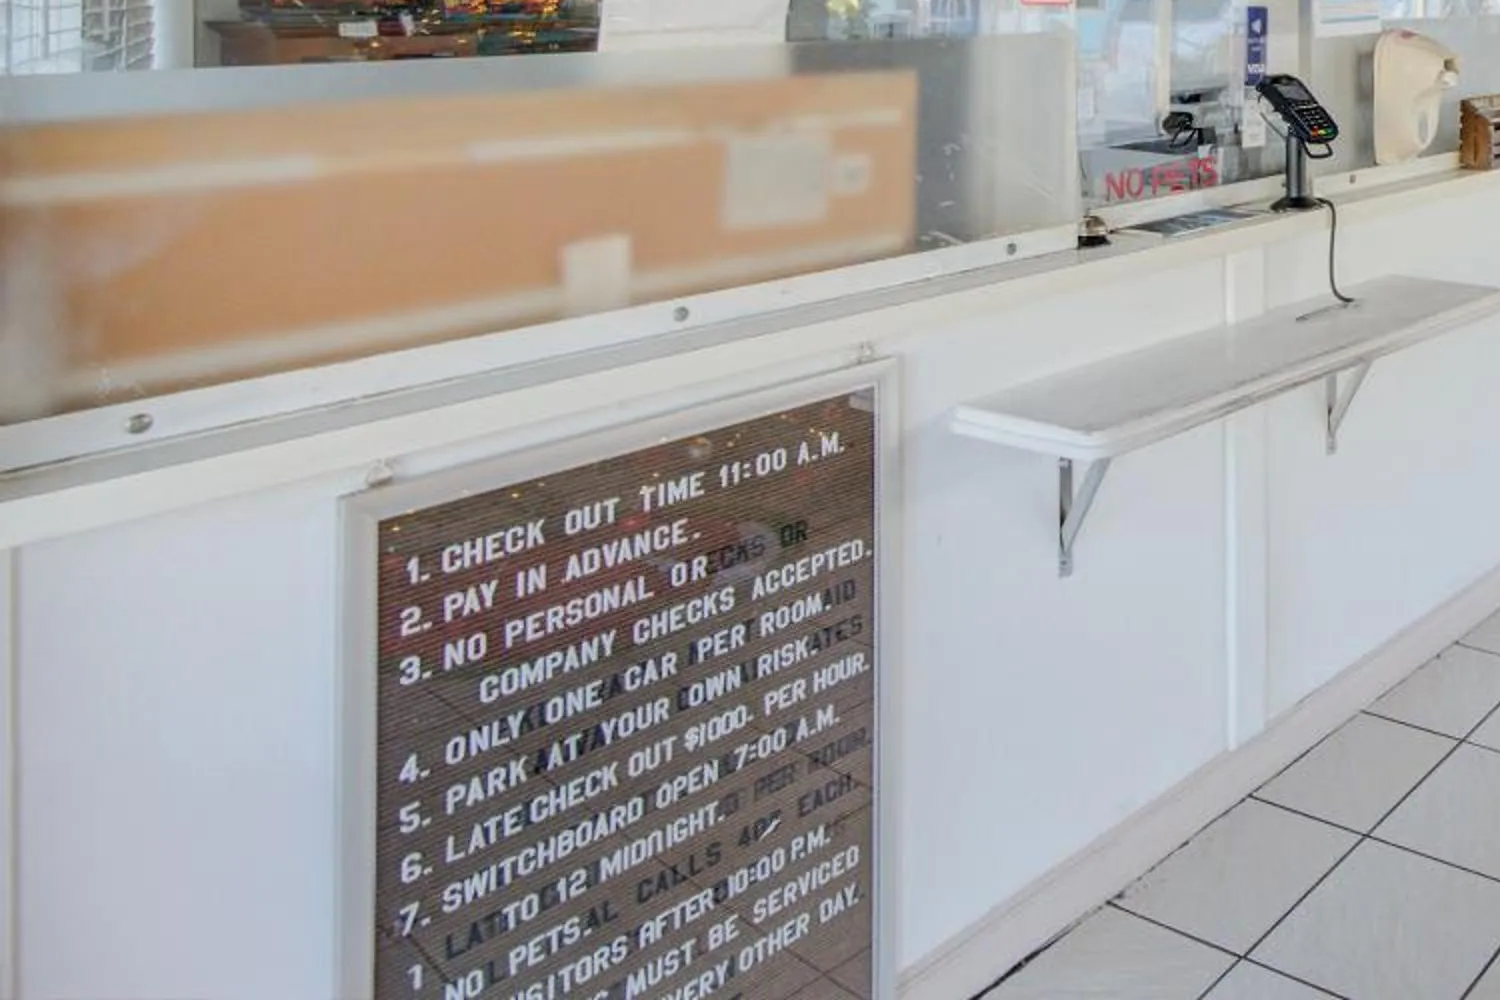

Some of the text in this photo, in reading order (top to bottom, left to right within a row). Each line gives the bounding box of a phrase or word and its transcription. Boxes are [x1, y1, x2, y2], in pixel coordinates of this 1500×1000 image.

[1105, 156, 1219, 201] NO PETS
[400, 517, 702, 637] 2. PAY IN ADVANCE.
[406, 430, 845, 584] 1. CHECK OUT TIME 11:00 A.M.
[399, 554, 709, 685] 3. NO PERSONAL OR
[399, 592, 832, 784] 4. ONLY ONE CAR PER ROOM.
[479, 538, 873, 704] COMPANY CHECKS ACCEPTED.
[399, 638, 818, 834] 5. PARK AT YOUR OWN RISK.
[400, 851, 433, 884] 6.
[445, 805, 524, 863] LATE
[530, 761, 619, 823] CHECK
[628, 736, 677, 778] OUT
[764, 679, 806, 716] PER
[813, 652, 871, 694] HOUR.
[399, 704, 840, 937] 7. SWITCHBOARD OPEN 7:00 A.M.
[445, 917, 592, 1000] NO PETS.
[501, 893, 540, 931] TO
[556, 868, 588, 903] 12
[510, 825, 832, 1000] SITORS AFTER 10:00 P.M.
[626, 845, 861, 1000] MUST BE SERVICED
[739, 912, 810, 972] OTHER
[819, 883, 860, 923] DAY.
